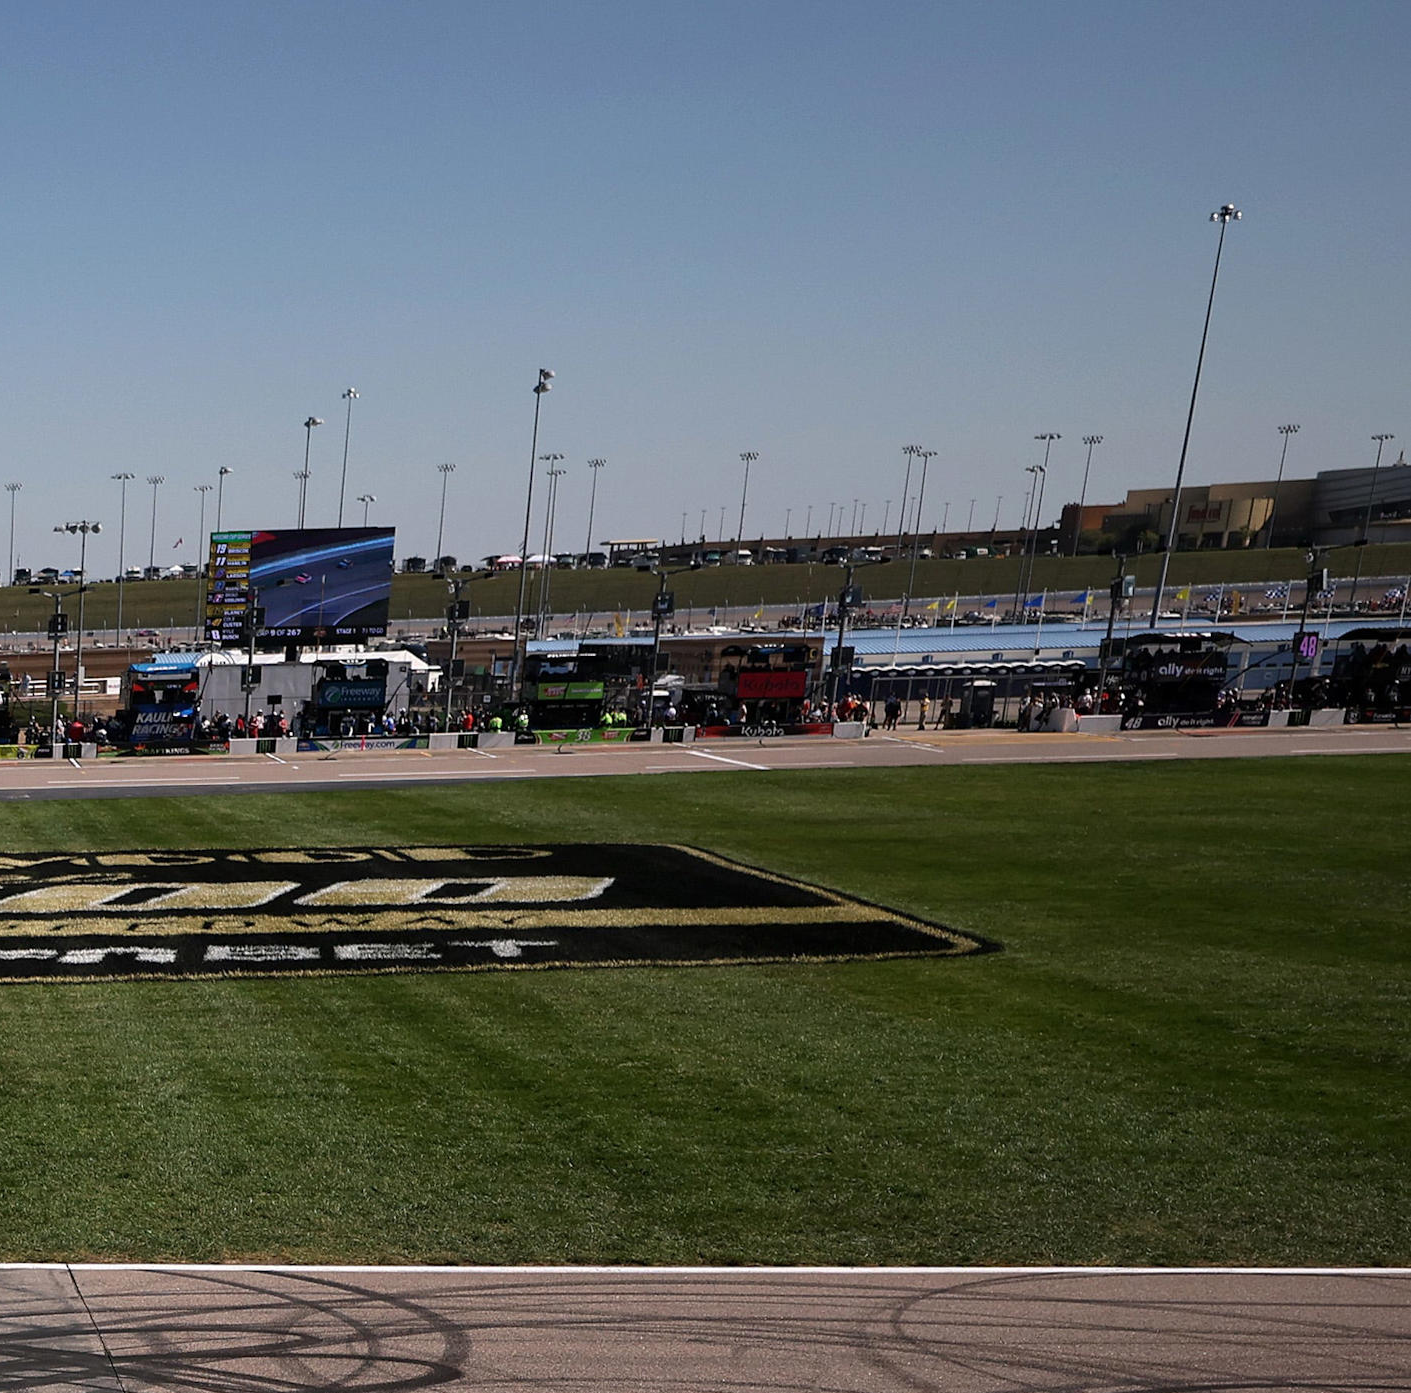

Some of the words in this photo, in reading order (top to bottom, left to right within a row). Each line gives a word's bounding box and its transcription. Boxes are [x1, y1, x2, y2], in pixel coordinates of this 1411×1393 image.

[217, 544, 227, 554] 19
[216, 557, 226, 566] 11
[286, 628, 302, 636] 267
[1300, 635, 1317, 657] 48
[1158, 662, 1184, 677] ally
[340, 686, 382, 697] Freeway
[1157, 715, 1179, 728] ally
[204, 939, 557, 962] BET
